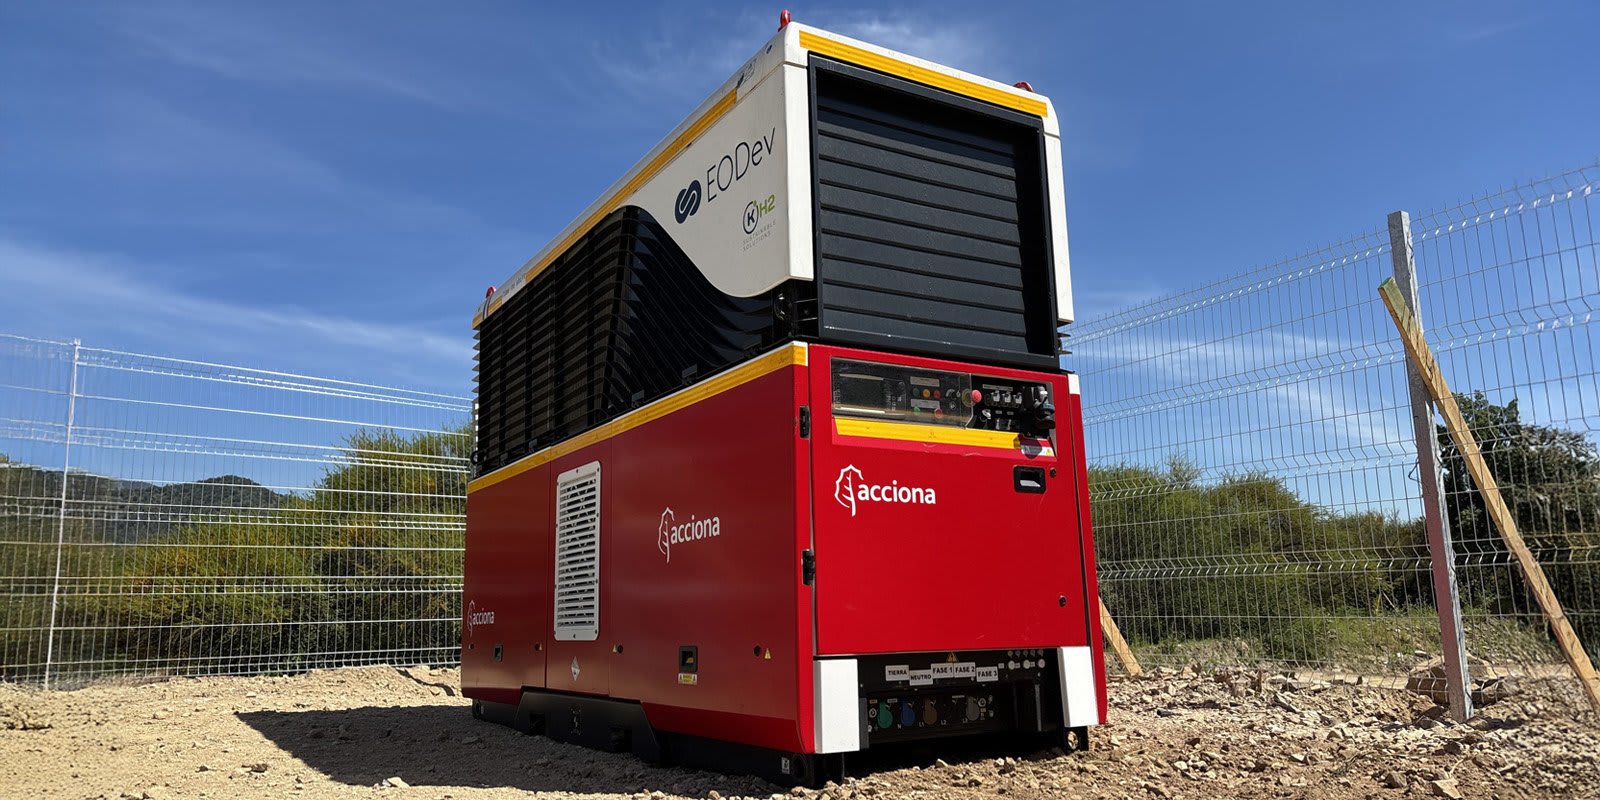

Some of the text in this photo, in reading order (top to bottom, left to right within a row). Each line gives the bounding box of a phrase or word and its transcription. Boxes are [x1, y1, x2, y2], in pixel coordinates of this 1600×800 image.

[707, 126, 776, 203] EODev
[742, 230, 771, 252] SOLUTIONS
[857, 479, 936, 505] acciona
[670, 514, 721, 545] acciona
[472, 607, 495, 626] acciona
[911, 673, 931, 681] NEUTRO
[933, 665, 953, 674] FASE 1
[955, 665, 975, 674] FASE 2
[977, 670, 992, 678] FASE
